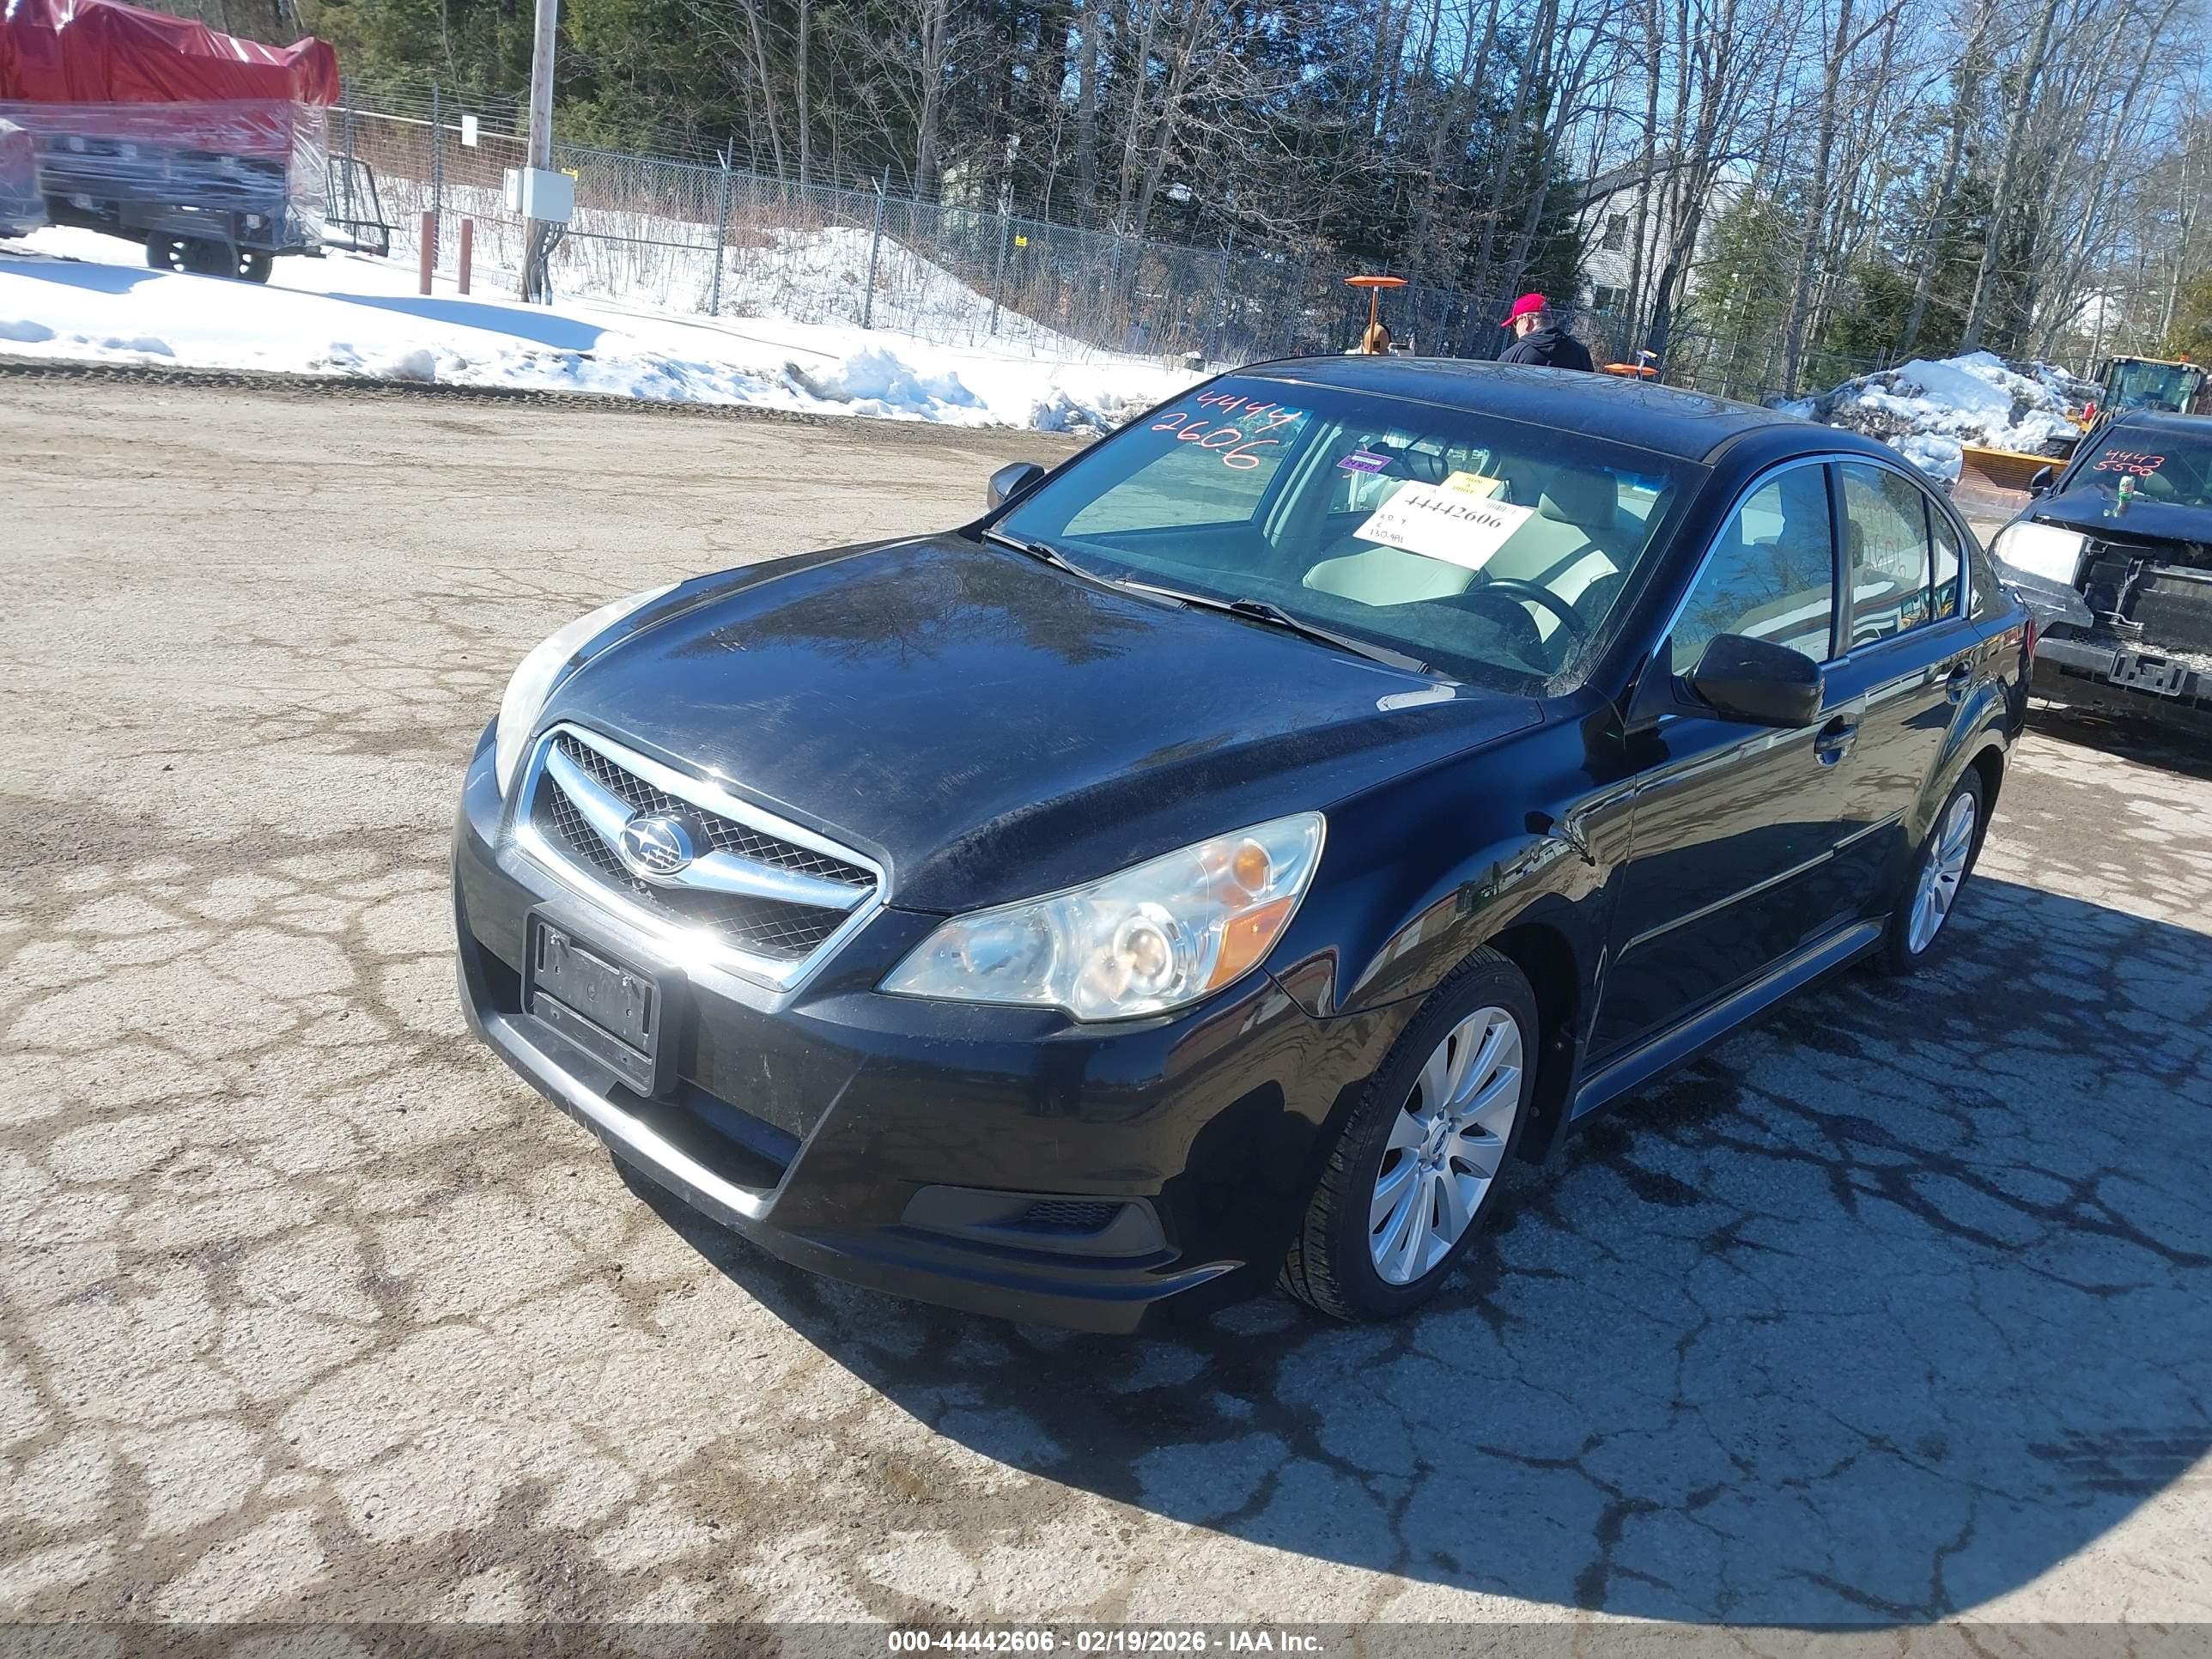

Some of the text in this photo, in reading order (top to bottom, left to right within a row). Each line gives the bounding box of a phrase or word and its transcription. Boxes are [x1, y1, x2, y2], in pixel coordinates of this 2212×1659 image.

[1196, 391, 1303, 434] 4444
[1152, 412, 1279, 470] 2606
[2106, 449, 2165, 468] 4443
[1404, 495, 1502, 529] 44442606
